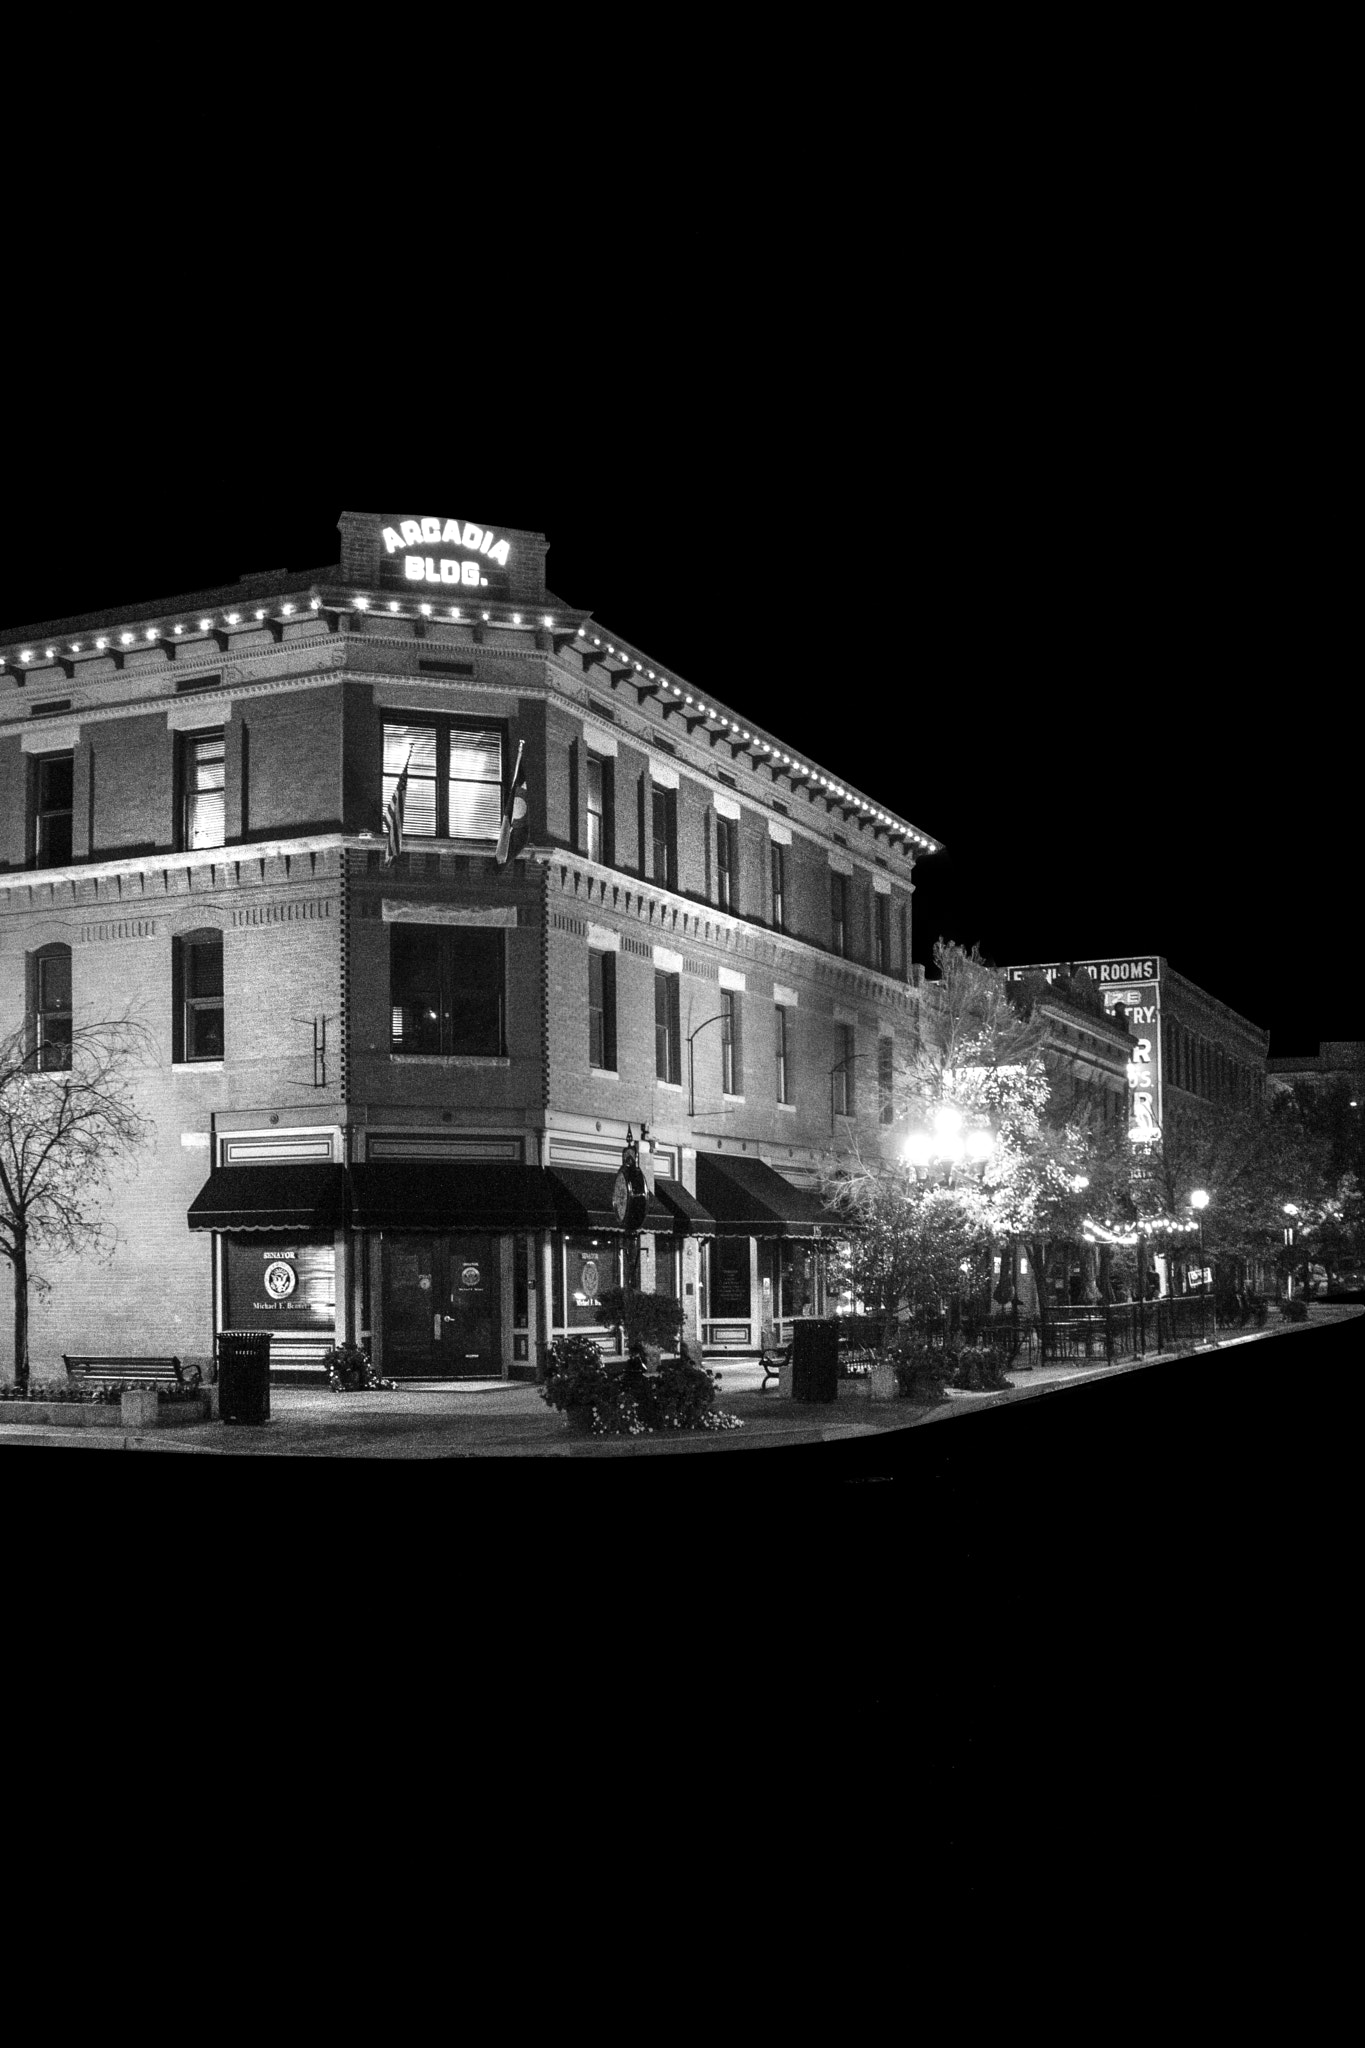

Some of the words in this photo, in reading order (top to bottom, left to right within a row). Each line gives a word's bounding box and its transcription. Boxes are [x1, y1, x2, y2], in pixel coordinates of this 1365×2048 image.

[383, 517, 510, 566] ARCADIA
[405, 555, 488, 586] BLDG.
[1100, 961, 1153, 982] ROOMS
[263, 1251, 296, 1259] SENATOR
[253, 1302, 277, 1310] Michael
